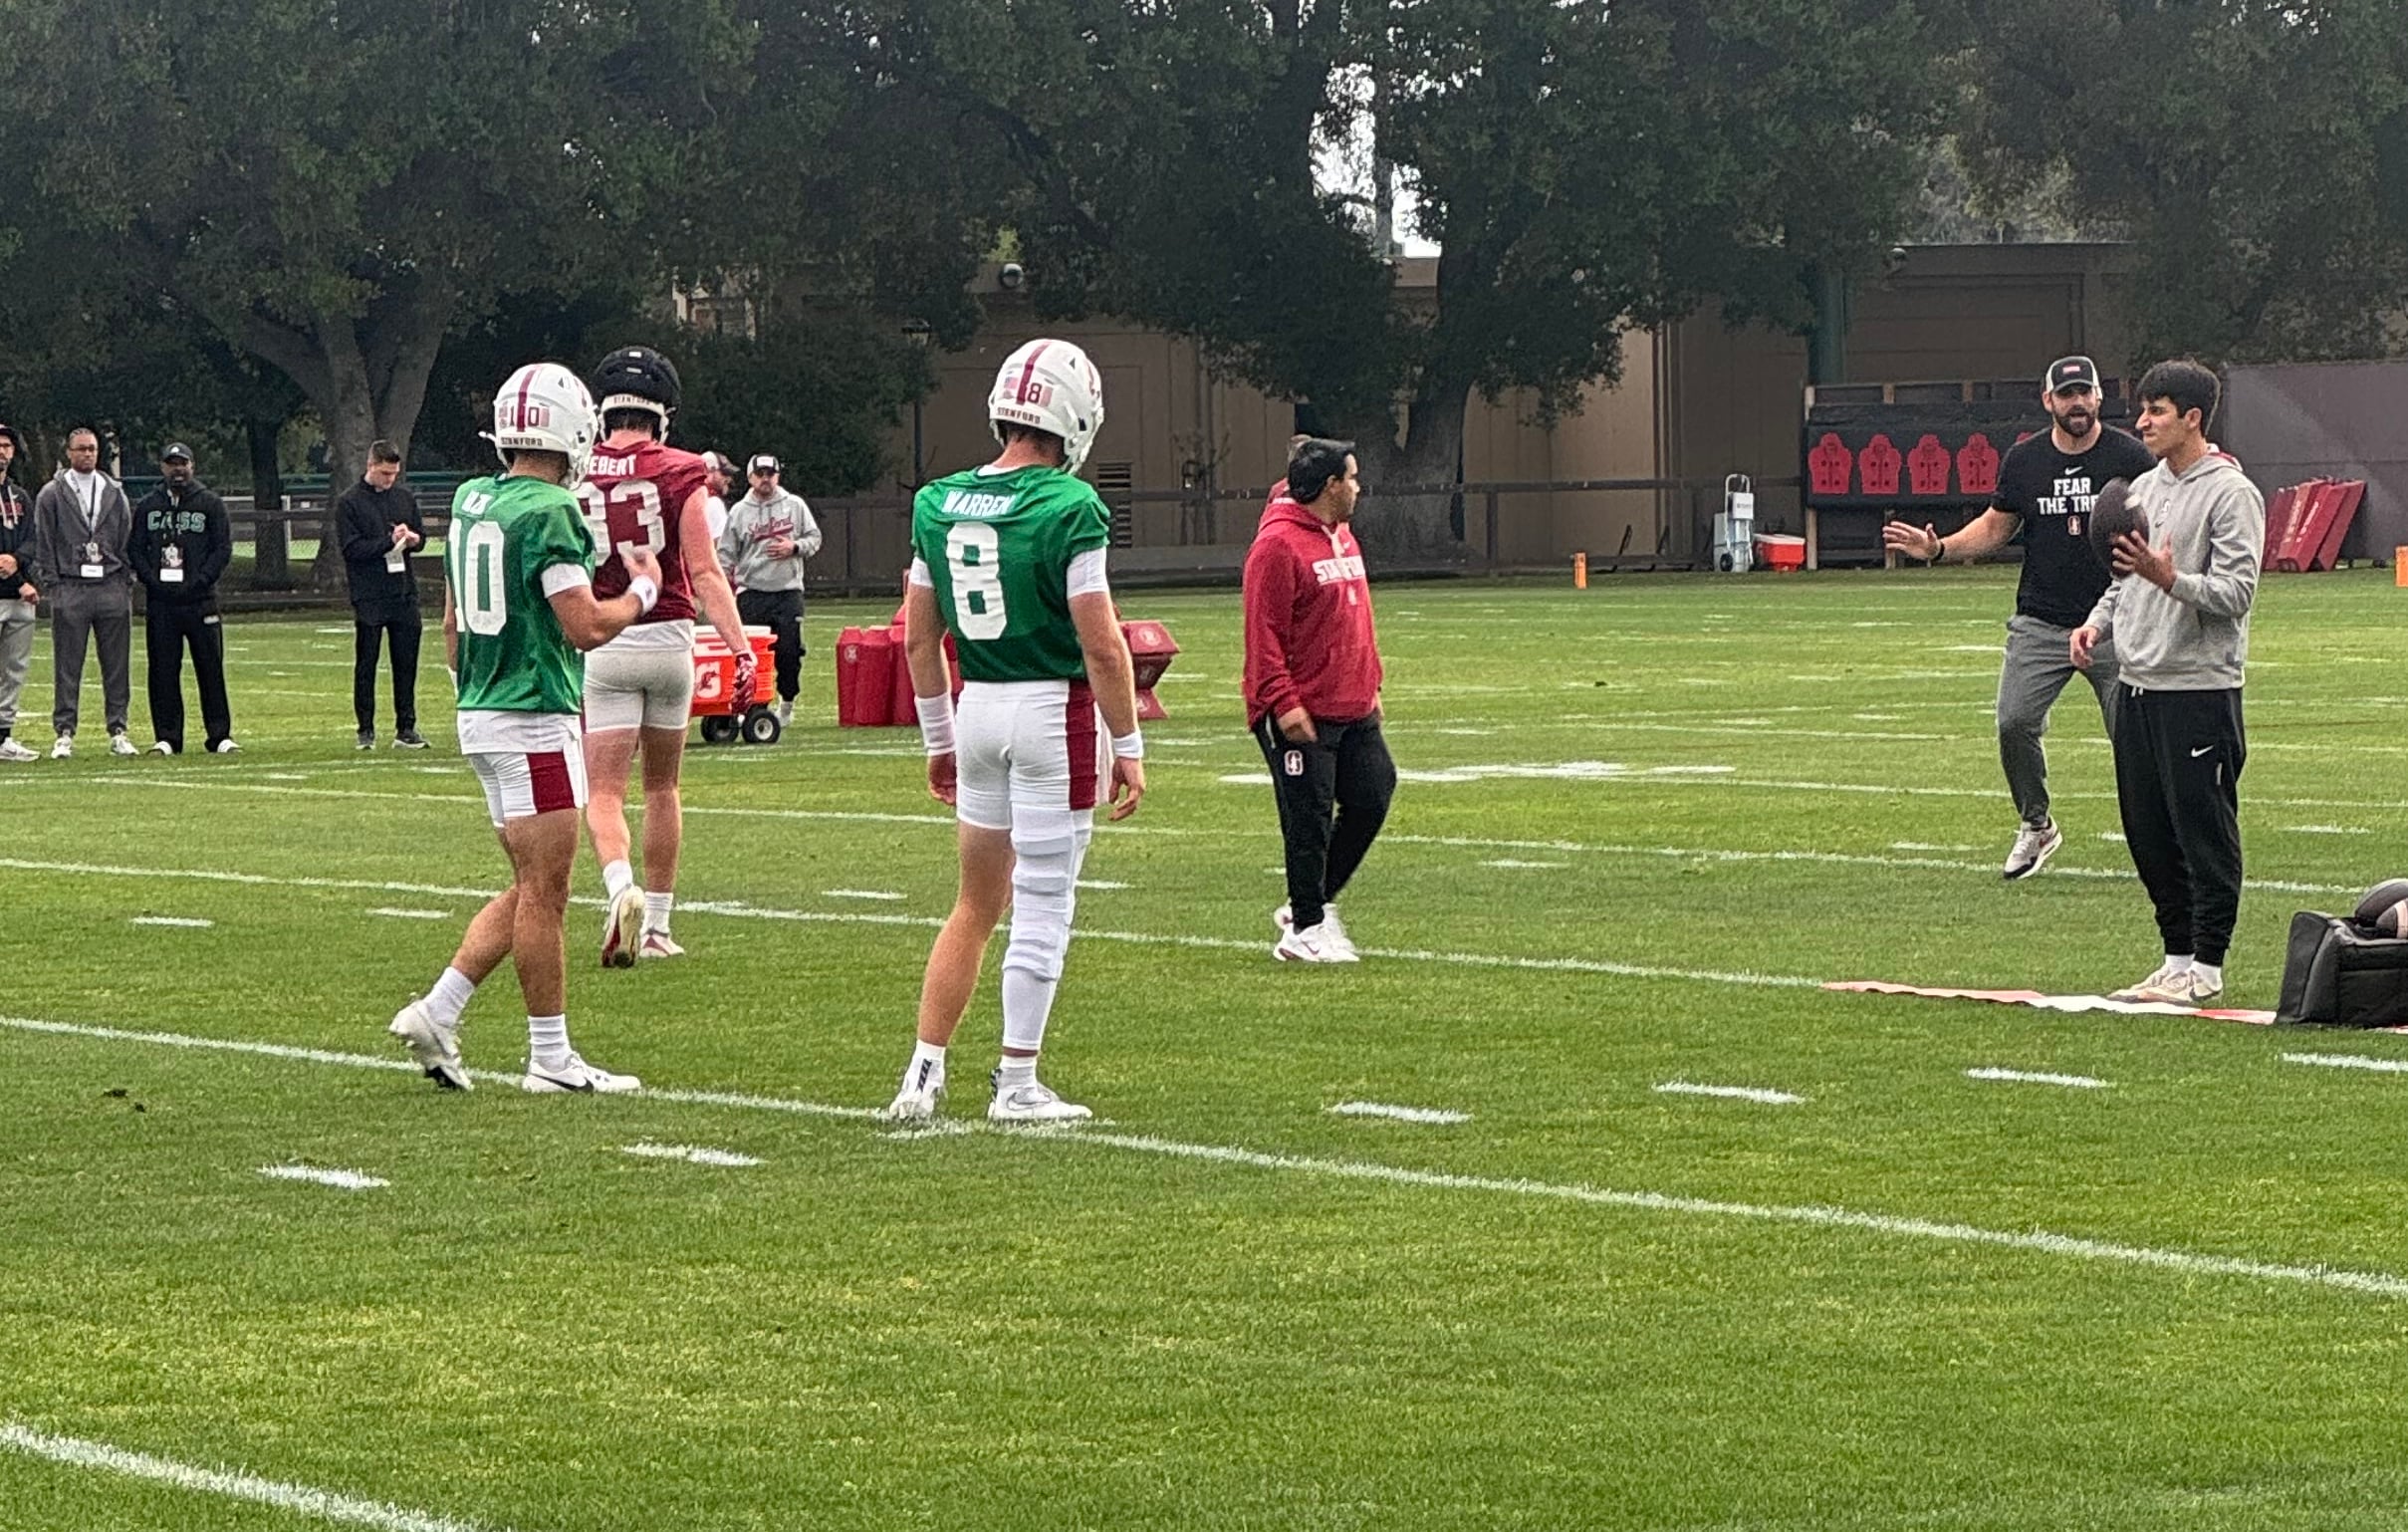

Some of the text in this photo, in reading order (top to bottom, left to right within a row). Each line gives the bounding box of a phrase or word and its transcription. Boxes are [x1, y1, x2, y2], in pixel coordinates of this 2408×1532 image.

[1027, 383, 1043, 404] 8
[509, 405, 540, 428] 10
[997, 406, 1041, 424] STANFORD
[584, 454, 636, 476] EBERT
[2053, 477, 2090, 496] FEAR
[942, 490, 1016, 517] WARREN
[2037, 498, 2067, 514] THE
[147, 510, 206, 533] CASS
[448, 517, 507, 636] 10
[945, 521, 1008, 640] 8
